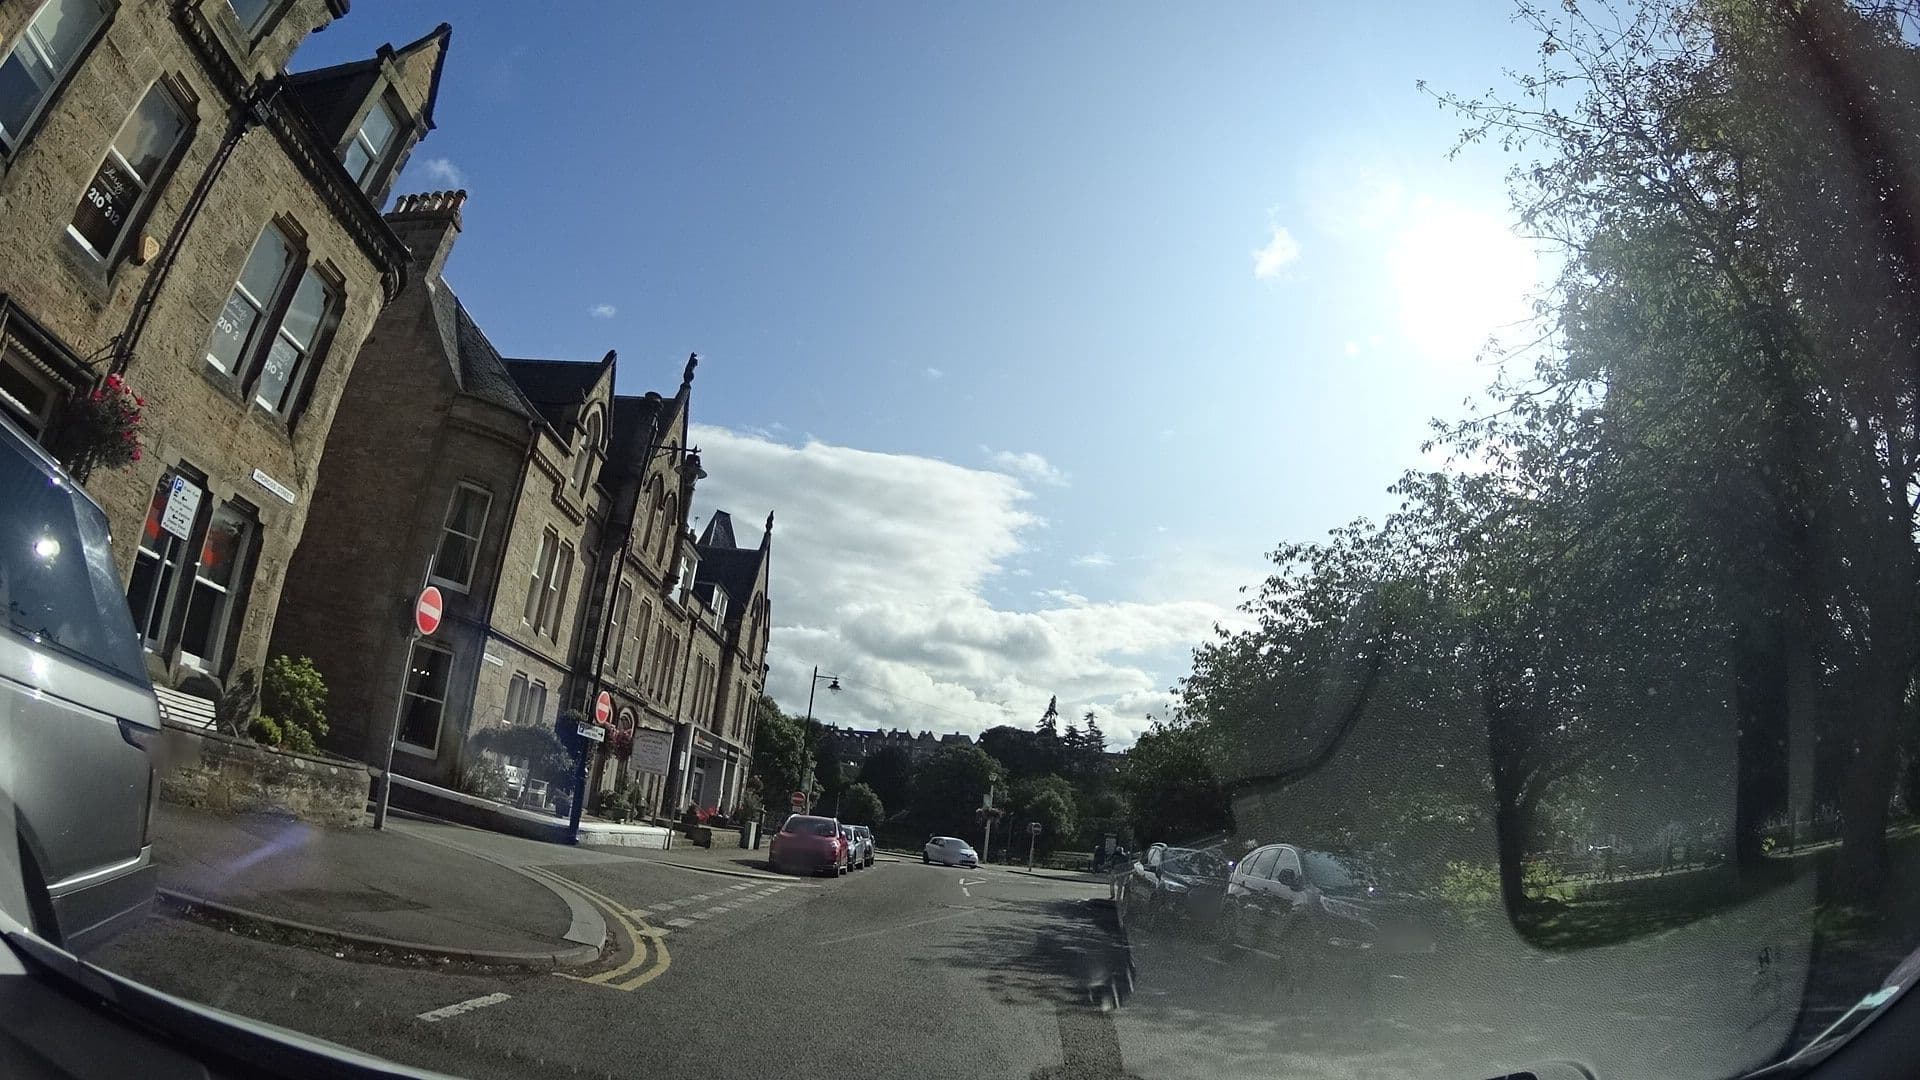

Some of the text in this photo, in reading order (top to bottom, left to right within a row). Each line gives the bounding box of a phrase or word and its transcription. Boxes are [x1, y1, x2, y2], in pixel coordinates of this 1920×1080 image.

[88, 187, 104, 208] 210
[105, 206, 120, 226] 312
[218, 316, 232, 334] 210
